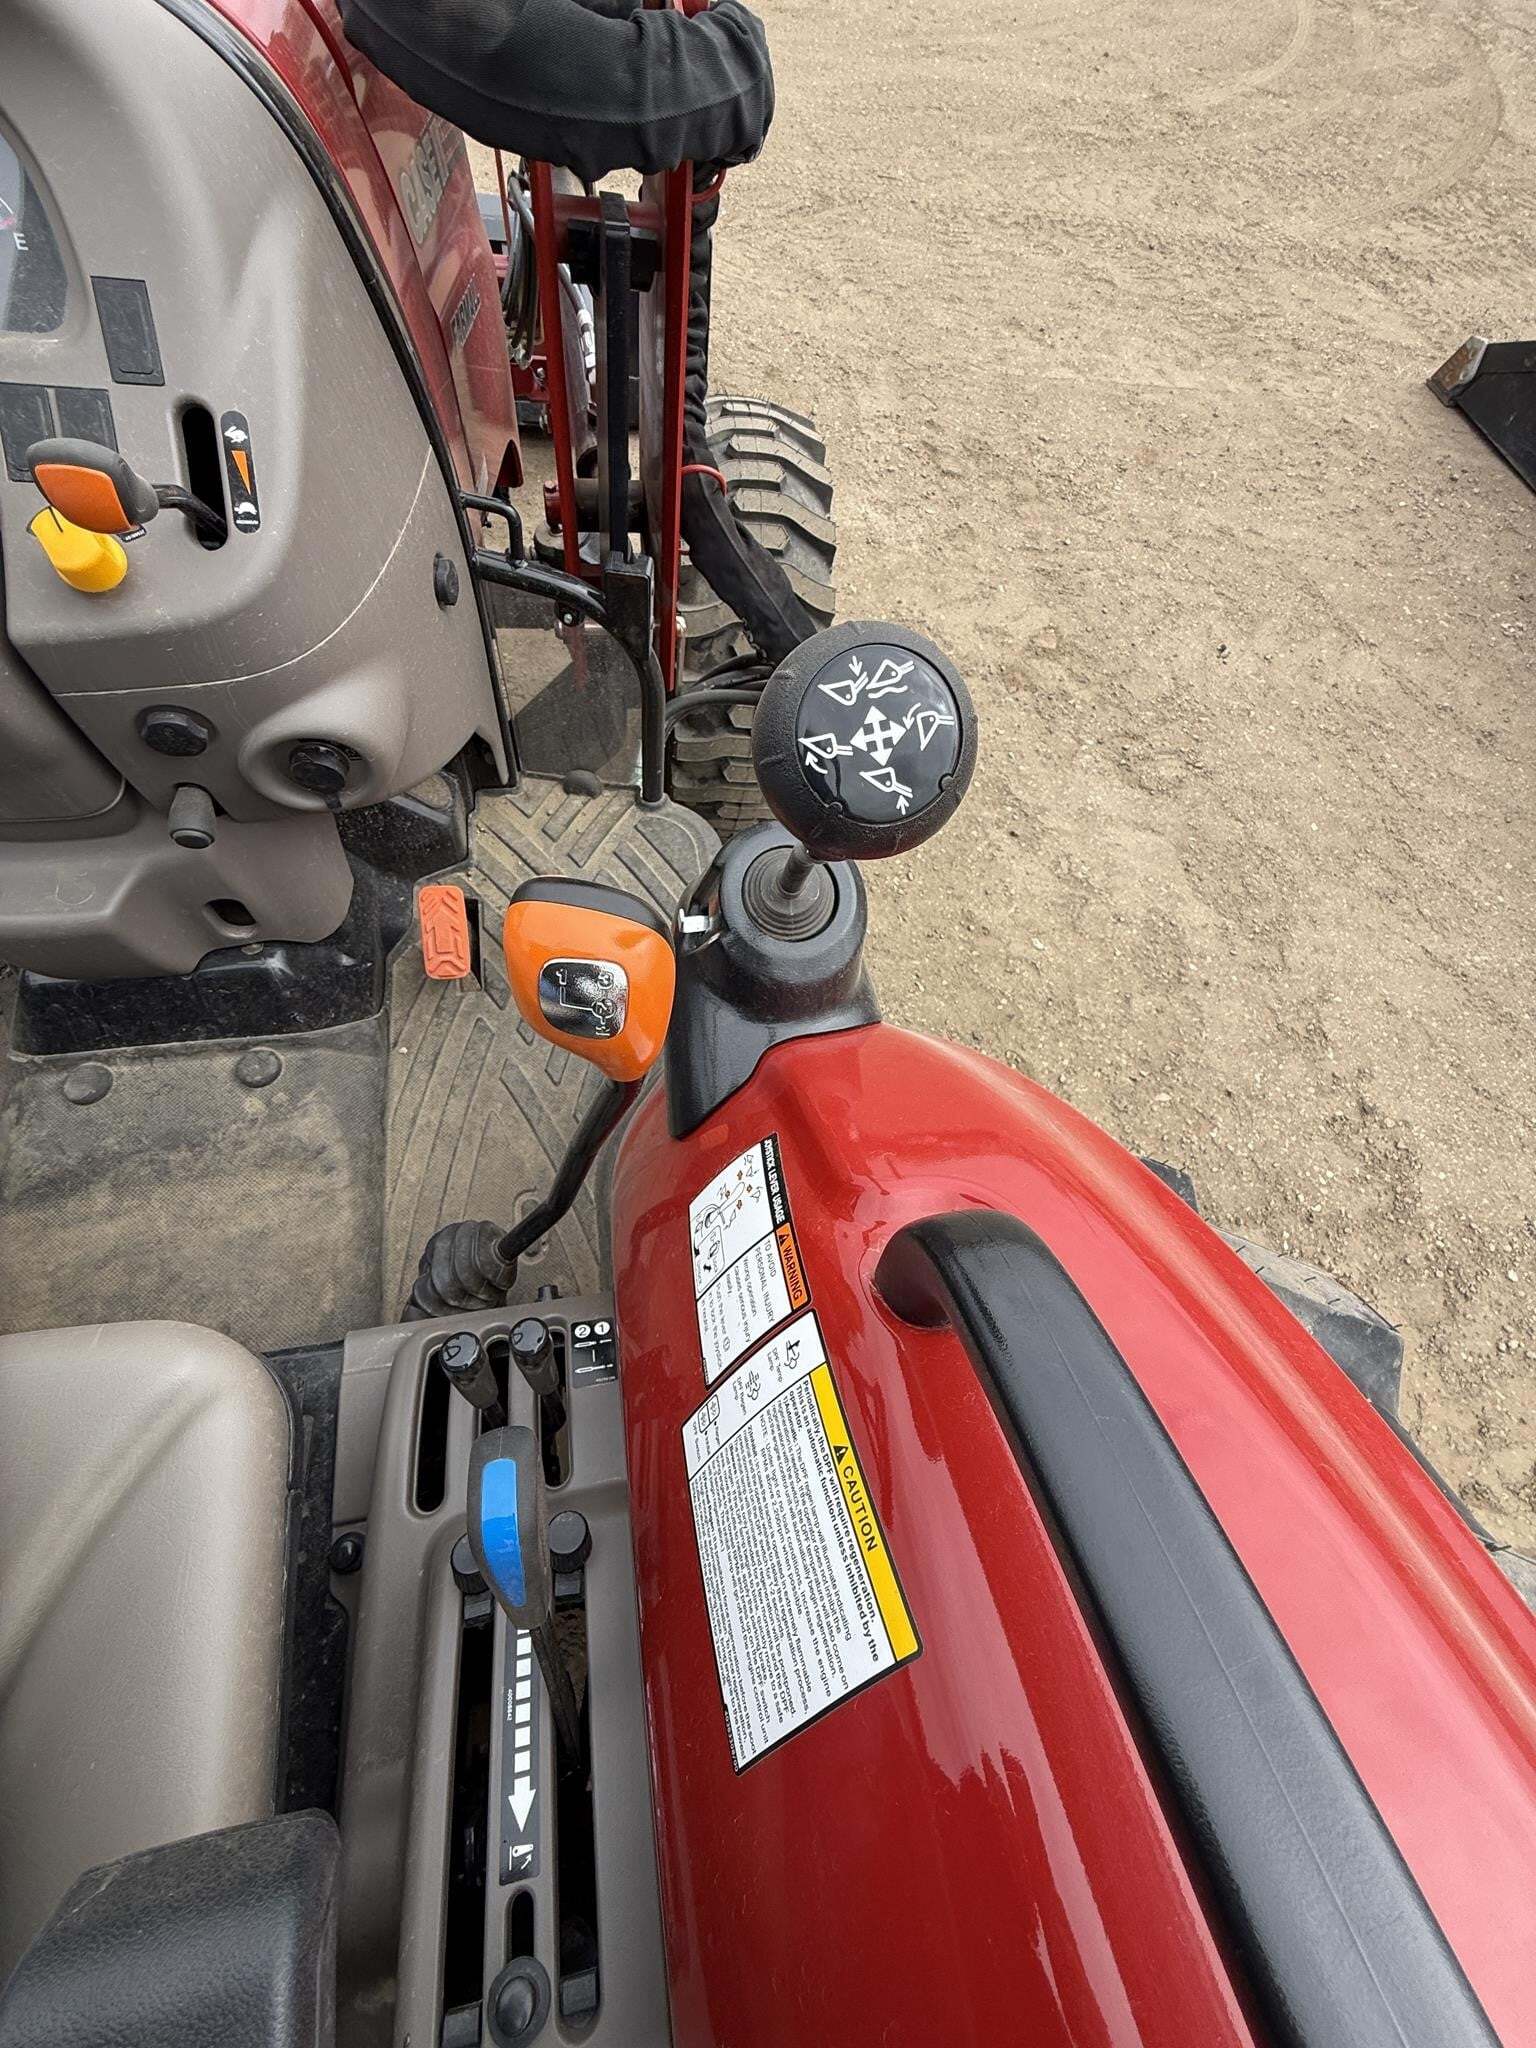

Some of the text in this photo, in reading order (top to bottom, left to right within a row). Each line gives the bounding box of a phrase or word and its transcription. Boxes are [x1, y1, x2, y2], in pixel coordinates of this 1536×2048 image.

[13, 232, 29, 251] E
[762, 1136, 785, 1224] JOYSTICK LEVER USAGE
[763, 1238, 776, 1279] TO AVOID
[782, 1243, 802, 1301] WARNING
[754, 1246, 775, 1325] PERSONAL INJURY
[576, 1325, 589, 1337] 2
[742, 1318, 751, 1344] injury
[787, 1389, 804, 1433] operator.
[765, 1442, 774, 1468] Under
[775, 1398, 791, 1447] regeneration
[802, 1505, 817, 1545] operator
[813, 1543, 824, 1569] does
[824, 1584, 837, 1616] inhibit
[784, 1488, 792, 1506] unit
[788, 1504, 796, 1520] will
[801, 1379, 878, 1624] Periodically, the DPF will require regeneration.
[802, 1480, 813, 1507] regen
[842, 1463, 878, 1552] CAUTION
[781, 1512, 790, 1535] load
[795, 1383, 805, 1405] This
[806, 1425, 825, 1477] automatic
[820, 1475, 837, 1522] function
[832, 1521, 849, 1563] unless
[844, 1562, 867, 1620] inhibited
[867, 1638, 879, 1663] the
[809, 1504, 821, 1530] lamp
[816, 1527, 825, 1545] will
[781, 1543, 792, 1571] when
[785, 1534, 804, 1590] conditions,
[791, 1519, 811, 1581] automatically
[804, 1542, 826, 1603] temperature
[820, 1543, 838, 1591] illuminate
[763, 1501, 773, 1530] tractor
[770, 1537, 785, 1580] operated
[782, 1588, 799, 1639] extremely
[794, 1636, 812, 1693] flammable
[799, 1589, 816, 1636] increase
[806, 1578, 819, 1610] begin
[821, 1600, 831, 1620] will
[832, 1589, 852, 1642] indicating
[749, 1613, 762, 1652] parking
[758, 1566, 775, 1627] regeneration
[771, 1625, 779, 1643] will
[777, 1657, 796, 1719] postponed.
[760, 1604, 775, 1651] moments
[769, 1560, 780, 1588] delay
[778, 1602, 798, 1668] regeneration
[793, 1668, 808, 1715] process,
[813, 1607, 837, 1679] regeneration.
[825, 1618, 837, 1643] also
[755, 1614, 767, 1650] quickly
[763, 1650, 773, 1680] move
[774, 1699, 784, 1724] safe
[816, 1656, 831, 1699] engine
[831, 1641, 844, 1675] come
[738, 1678, 748, 1712] before
[748, 1729, 756, 1755] soot
[745, 1649, 756, 1686] engine
[753, 1684, 764, 1723] control
[760, 1722, 768, 1744] unit
[759, 1688, 770, 1724] switch
[735, 1724, 746, 1760] lowest
